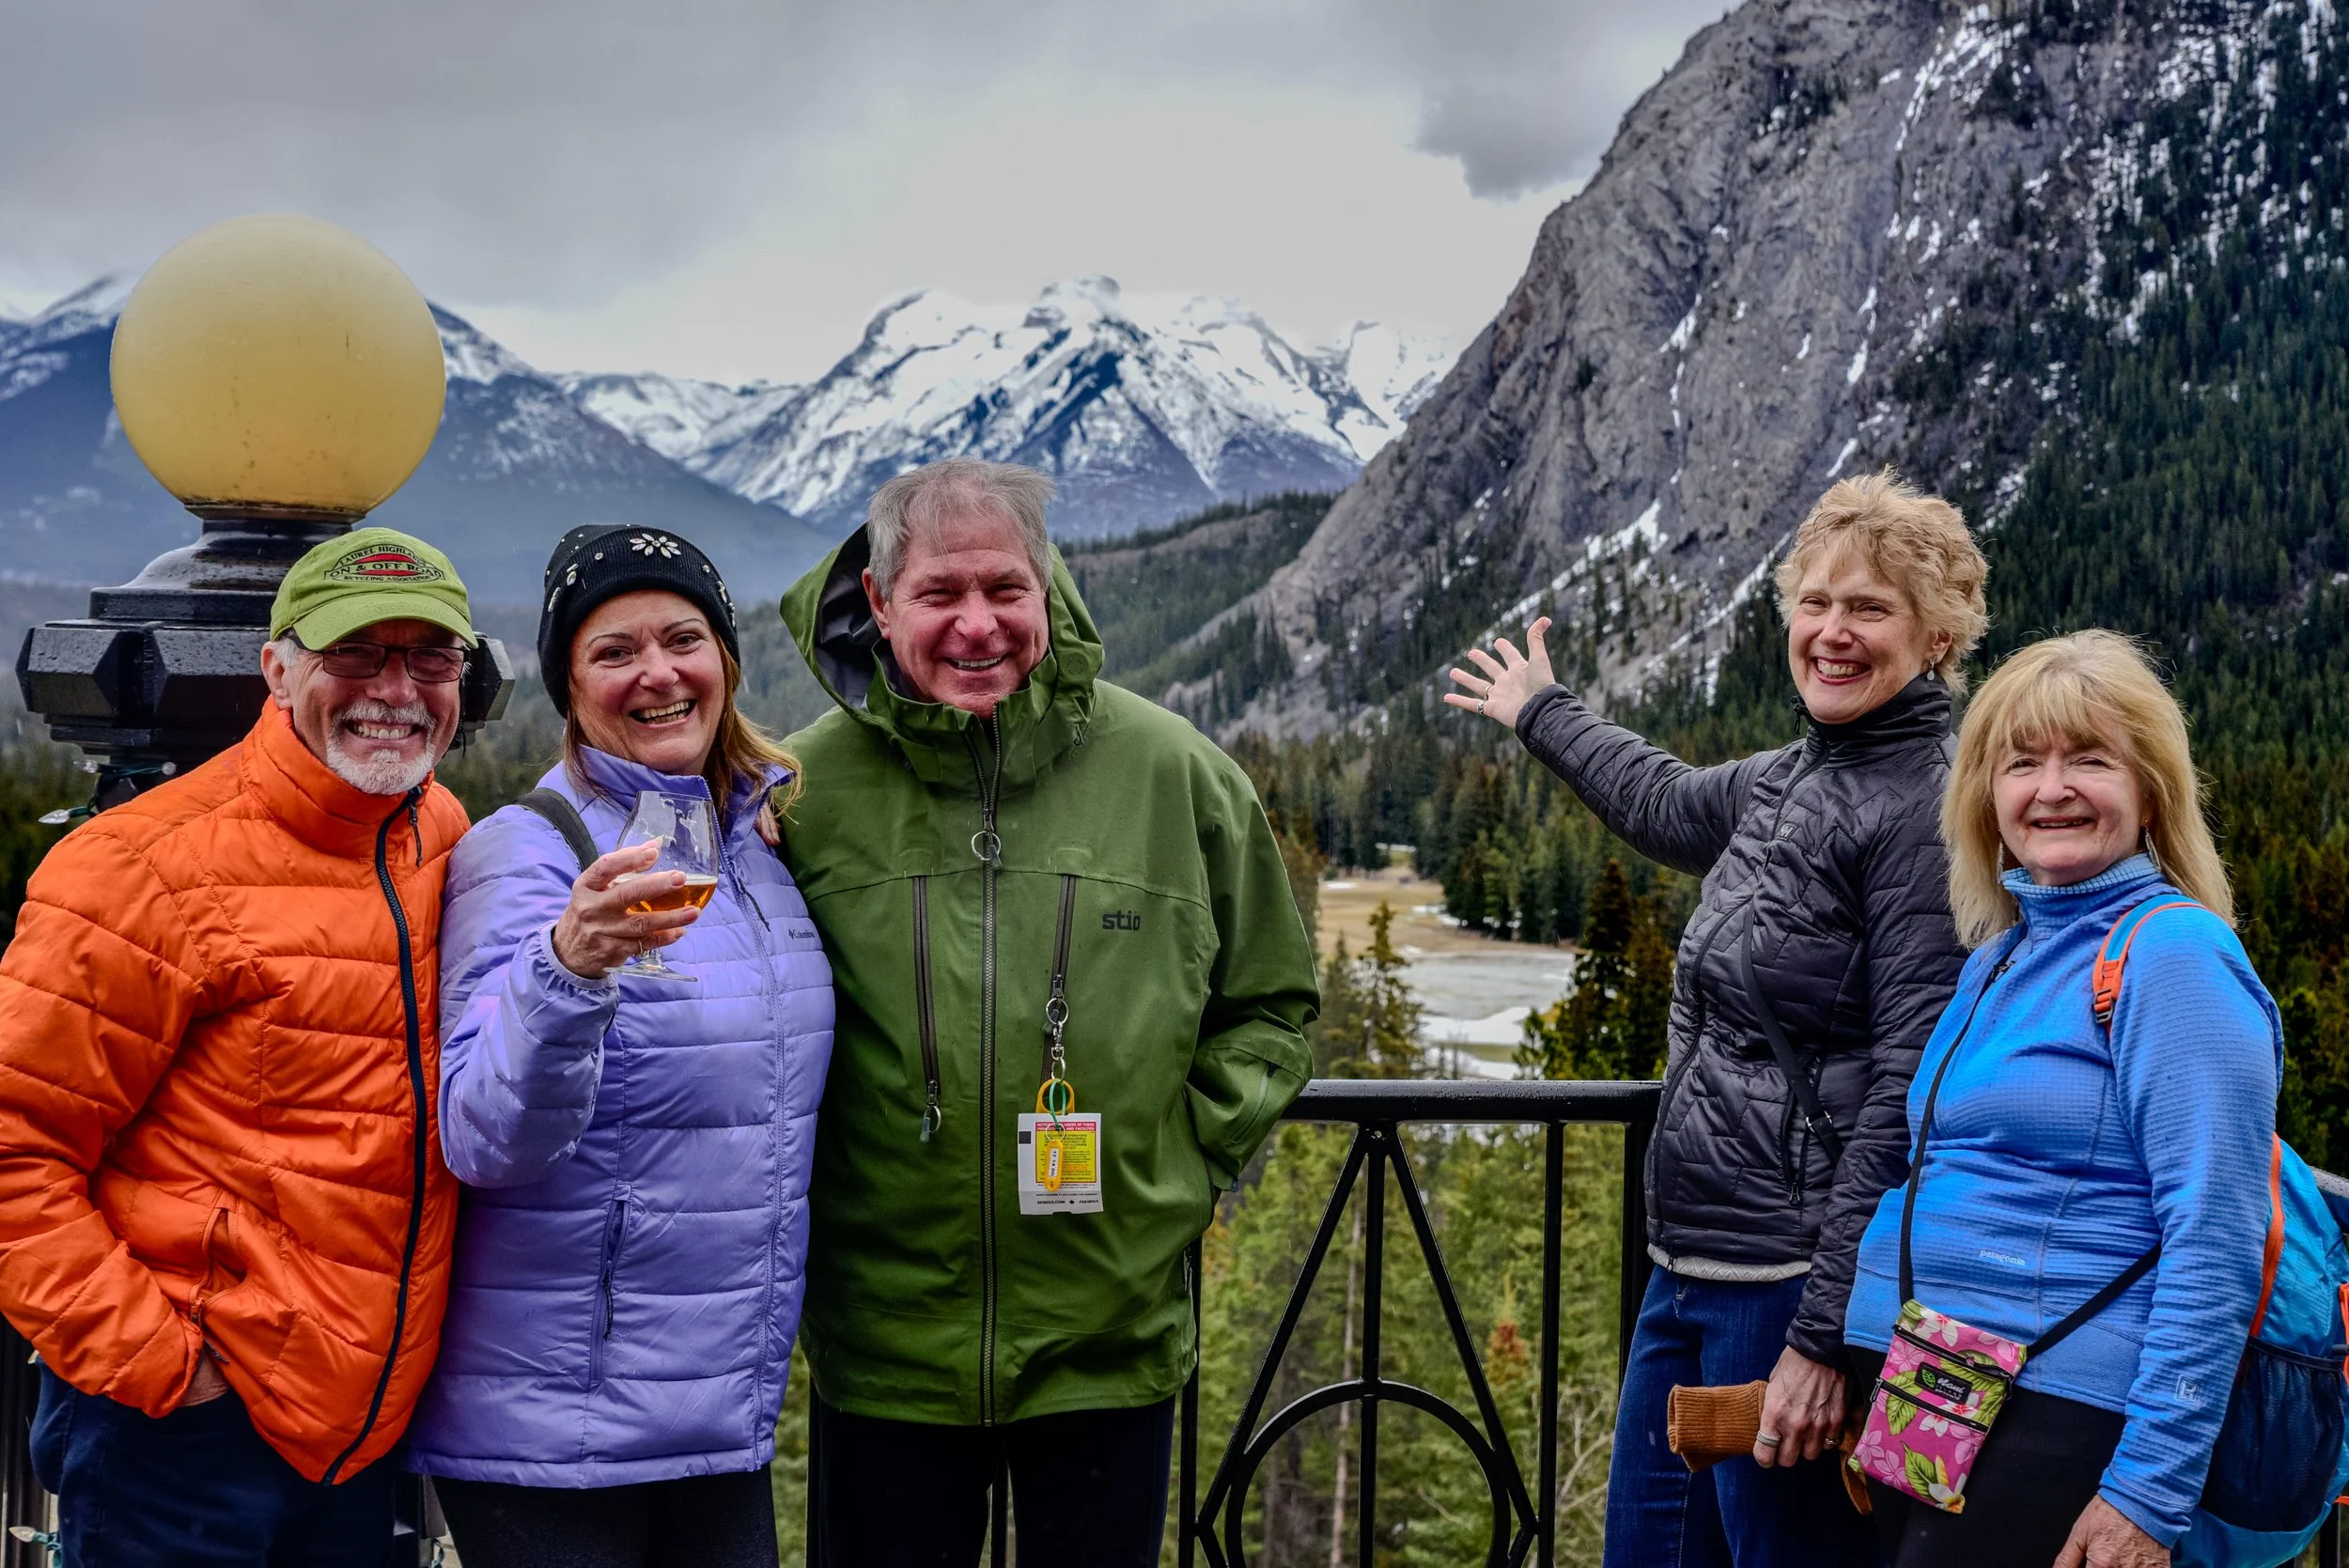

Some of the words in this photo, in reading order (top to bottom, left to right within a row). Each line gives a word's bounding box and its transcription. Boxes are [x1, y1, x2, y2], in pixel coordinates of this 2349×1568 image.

[339, 548, 376, 566] LAUREL
[330, 567, 350, 578] ON
[407, 564, 442, 579] ROAD
[1102, 909, 1141, 931] stio
[1979, 1250, 2026, 1266] patagonia
